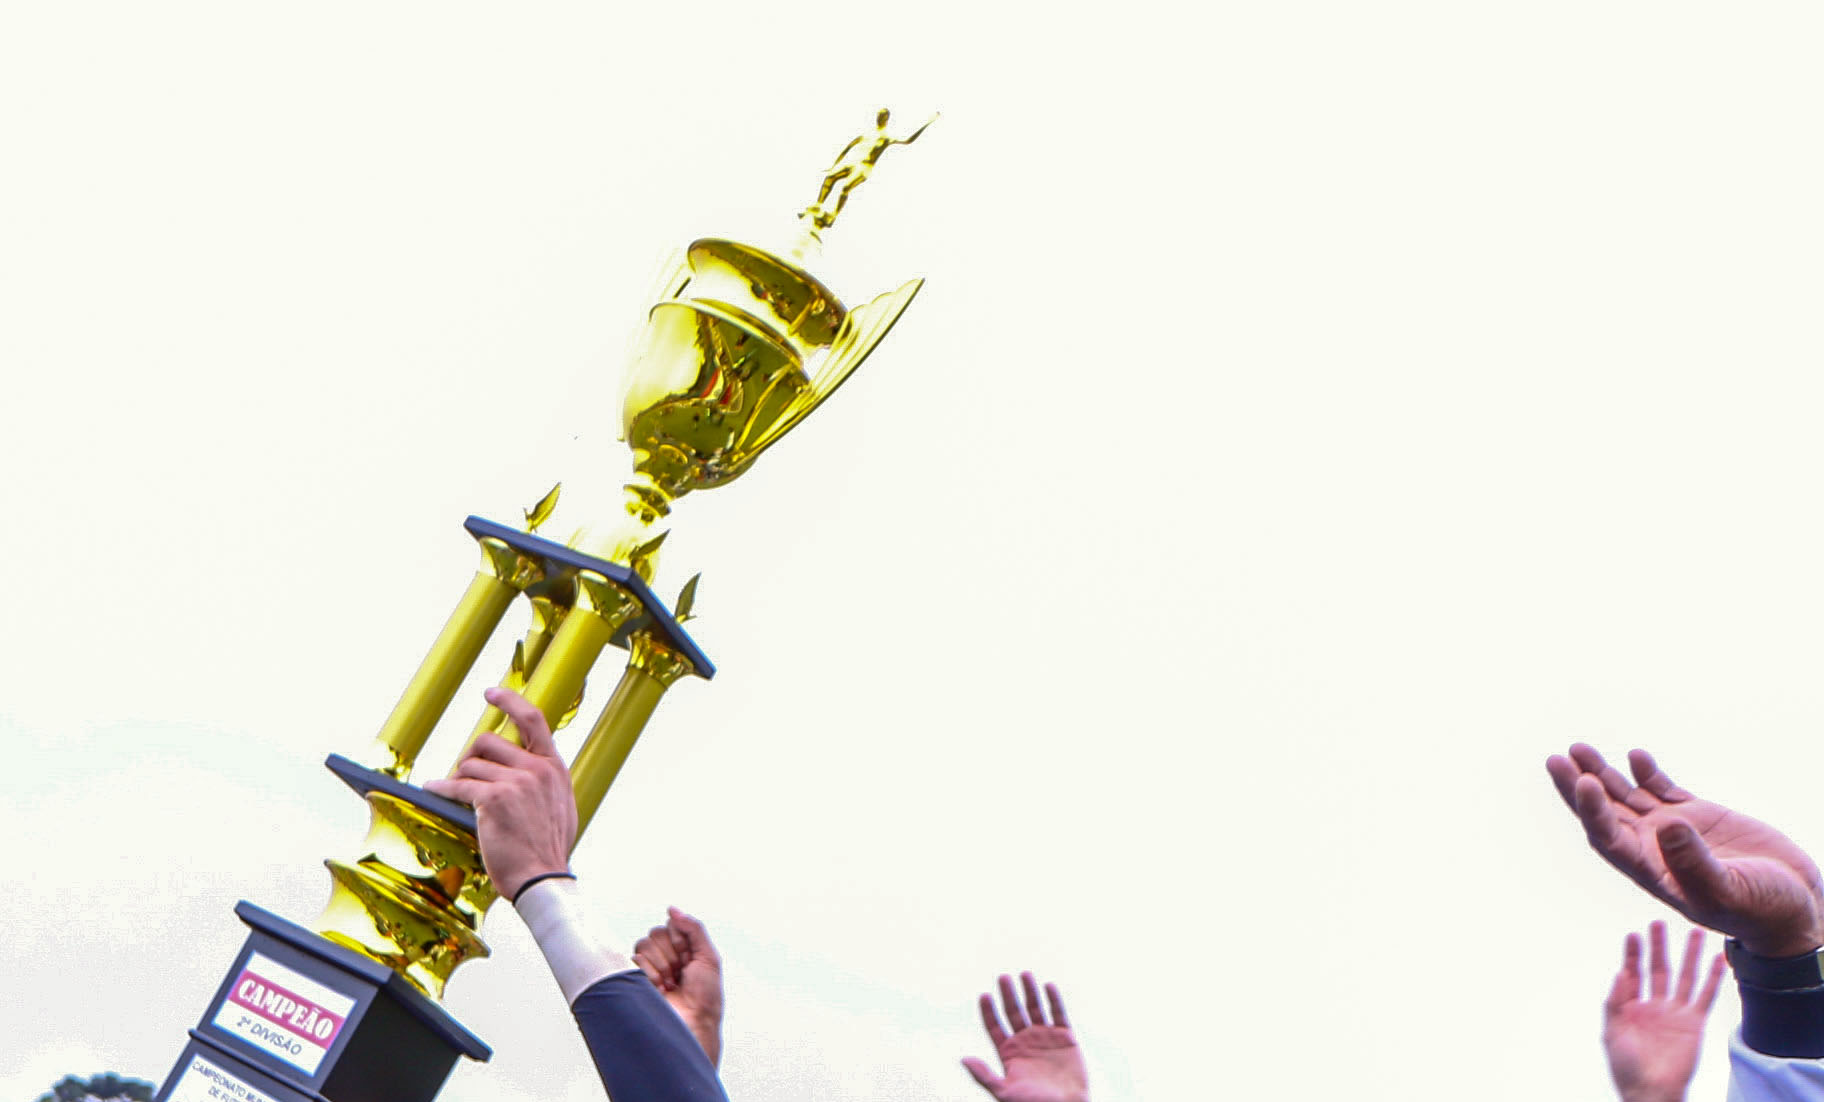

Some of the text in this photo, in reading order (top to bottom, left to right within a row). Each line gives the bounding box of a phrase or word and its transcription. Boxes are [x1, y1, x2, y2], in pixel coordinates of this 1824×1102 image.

[237, 977, 334, 1040] CAMPEÃO
[250, 1023, 303, 1055] DIVISÃO
[192, 1061, 246, 1098] CAMPEONATO
[207, 1085, 221, 1098] DE
